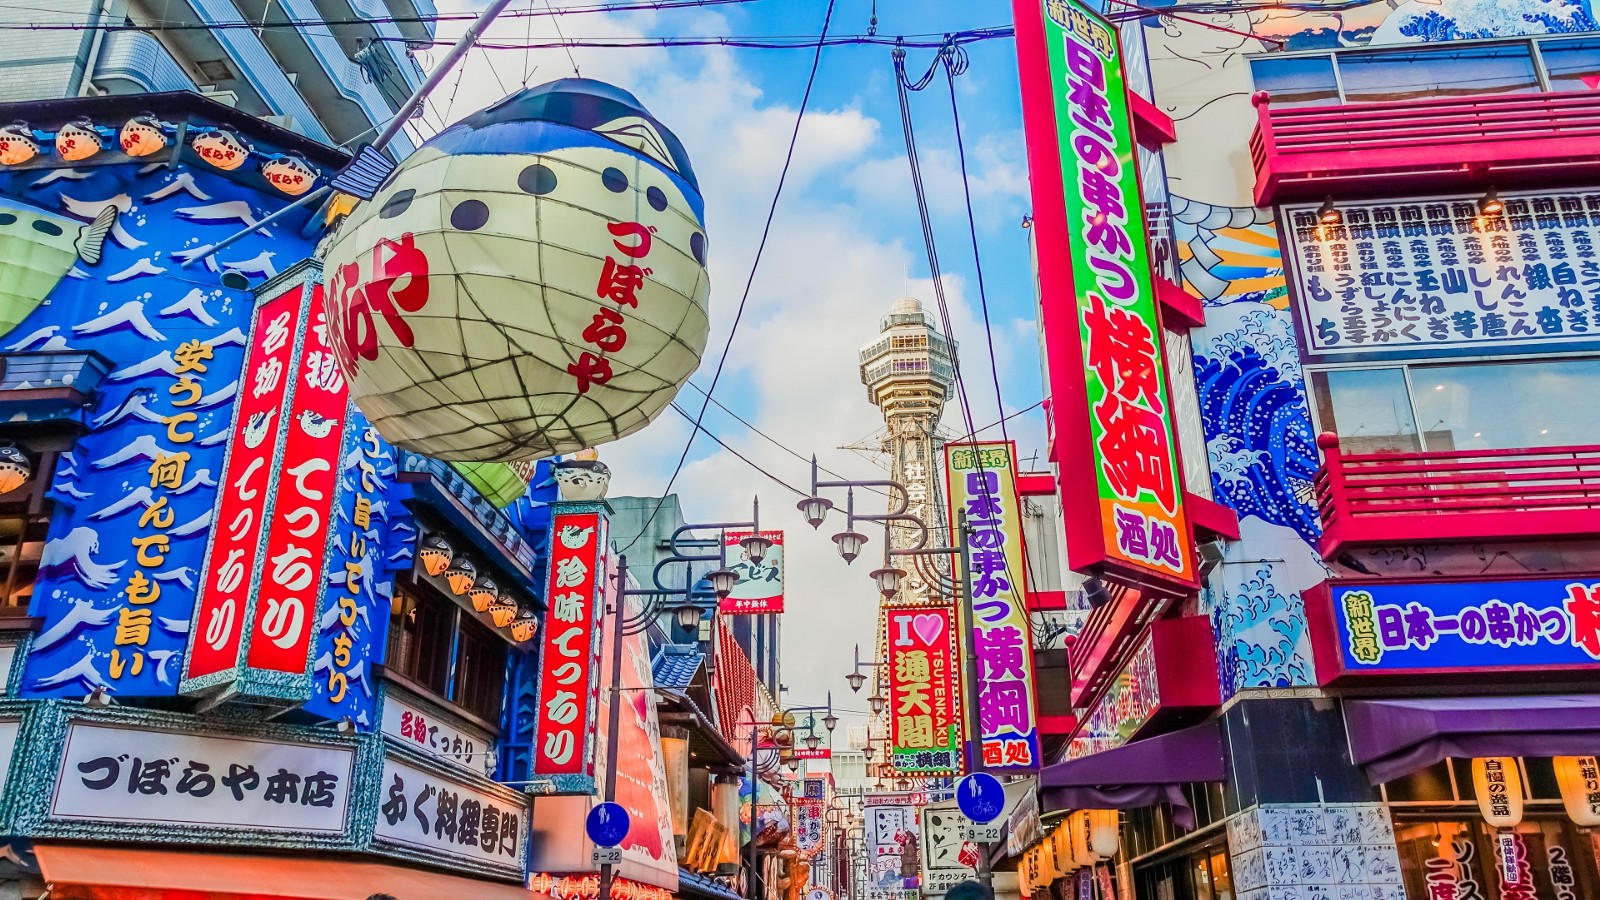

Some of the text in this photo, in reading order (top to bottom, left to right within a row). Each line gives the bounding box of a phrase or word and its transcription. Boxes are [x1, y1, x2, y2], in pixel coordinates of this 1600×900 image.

[1047, 0, 1112, 58] 新世界
[1294, 211, 1322, 243] 前頭
[1346, 208, 1375, 240] 前頭
[1372, 206, 1402, 238] 前頭
[1398, 204, 1429, 237] 前頭
[1558, 196, 1590, 229] 前頭
[1424, 203, 1455, 236] 前頭
[1441, 267, 1479, 339] 山芋
[1451, 202, 1483, 234] 前頭
[1468, 266, 1509, 337] しし唐
[1504, 199, 1536, 231] 前頭
[1522, 262, 1564, 335] 銀杏
[1531, 197, 1563, 230] 前頭
[1551, 261, 1589, 333] 白ねぎ
[567, 222, 658, 393] づぼらや
[1307, 275, 1341, 346] もち
[1335, 273, 1371, 343] うずら玉子
[1358, 271, 1399, 342] 紅しょうが
[1386, 271, 1421, 341] にんにく
[1413, 269, 1451, 340] 玉ねぎ
[1496, 265, 1537, 336] れんこん
[206, 310, 291, 651] 名物 てっちり
[953, 450, 1008, 469] 新世界
[109, 339, 214, 679] 安うて何んでも旨い
[1117, 508, 1180, 568] 酒処
[261, 457, 330, 650] てっちり
[735, 600, 768, 608] 年中無休
[1346, 594, 1380, 661] 新世界
[544, 555, 588, 765] 珍味てっちり
[895, 651, 934, 748] 通天閣
[932, 649, 949, 747] TSUTENKAKU
[401, 711, 474, 763] 名物てっちり
[982, 742, 1029, 765] 酒処
[77, 754, 338, 808] づぼらや本店
[382, 773, 518, 858] ふぐ料理専門
[1485, 760, 1511, 816] 自慢の逸品
[809, 805, 821, 842] 串かつ
